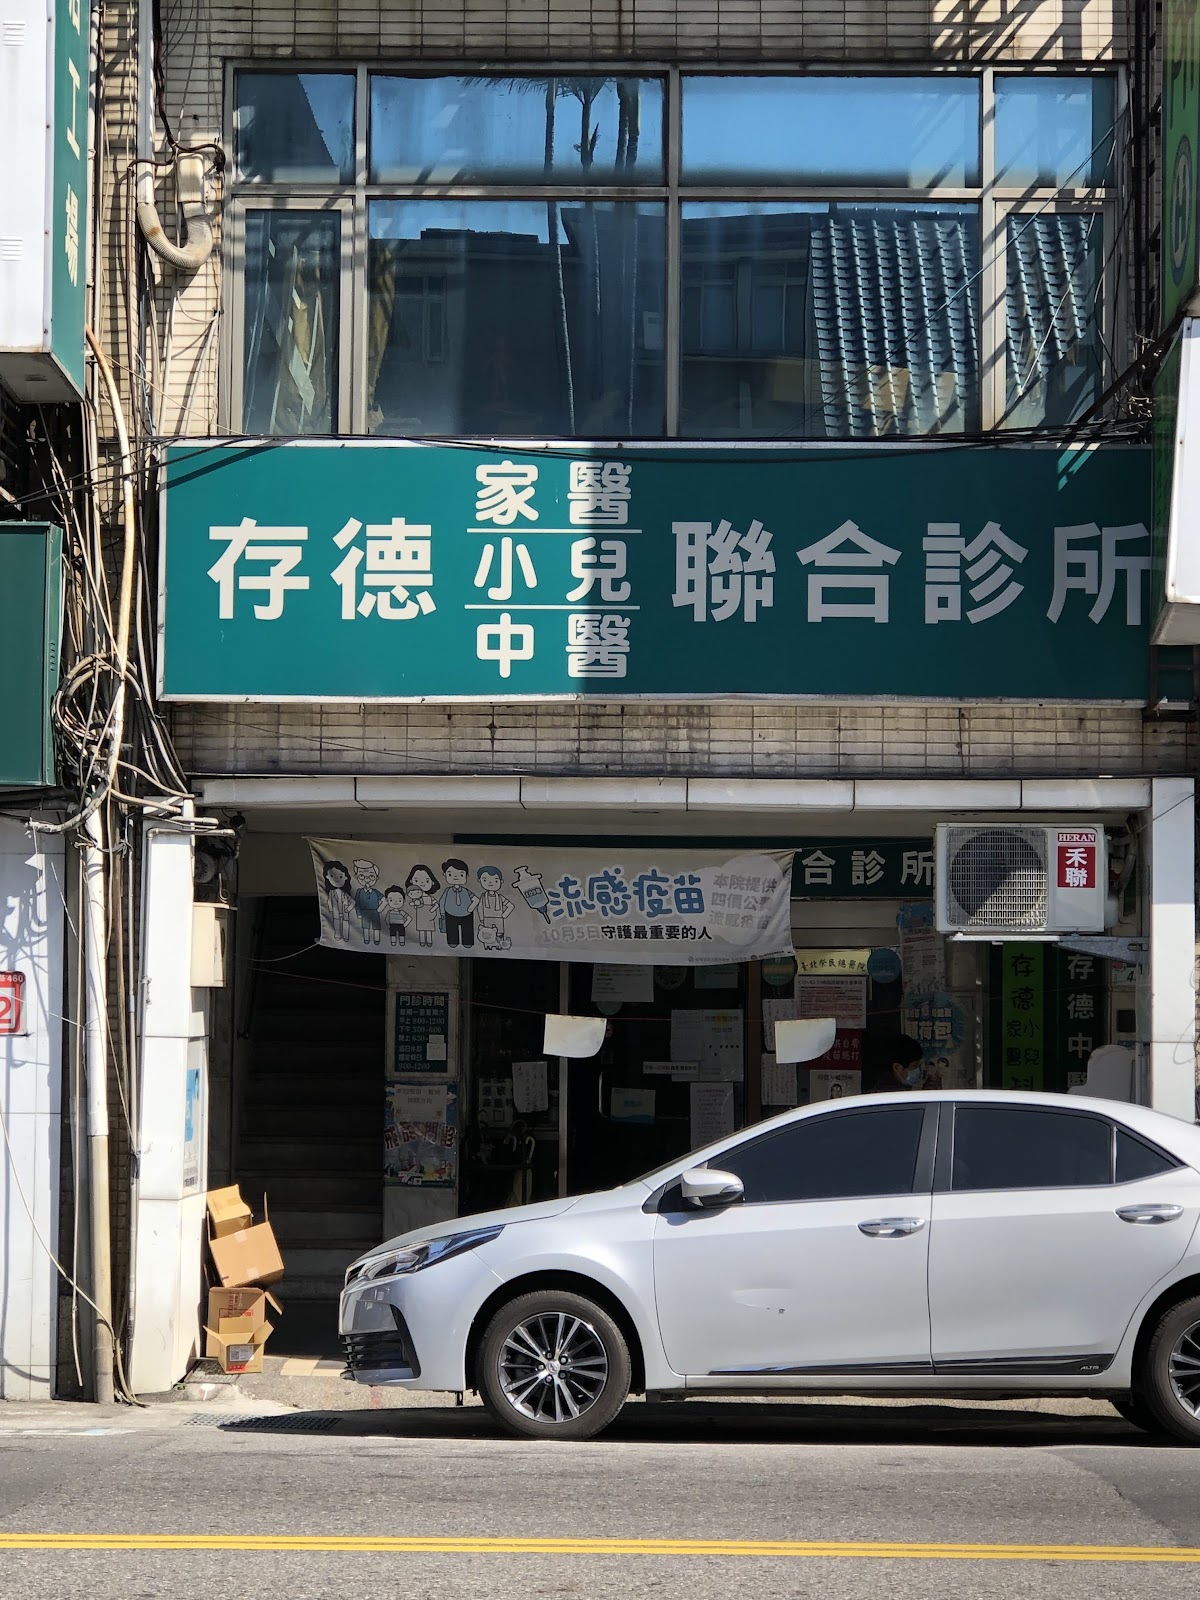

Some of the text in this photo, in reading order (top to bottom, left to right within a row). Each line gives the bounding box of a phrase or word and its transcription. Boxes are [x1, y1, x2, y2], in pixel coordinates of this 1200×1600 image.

[475, 460, 632, 526] 家醫
[206, 516, 1150, 626] 存德 聯合診所
[474, 536, 632, 602] 小兒
[476, 612, 631, 679] 中醫
[1058, 833, 1095, 842] HERAN
[713, 873, 778, 893] 本院提供
[801, 850, 935, 886] 合診所
[1065, 847, 1088, 887] 禾聯
[549, 867, 705, 918] 流感疫苗
[800, 958, 867, 972] 臺北榮民總醫院
[400, 995, 445, 1007] 門診時間
